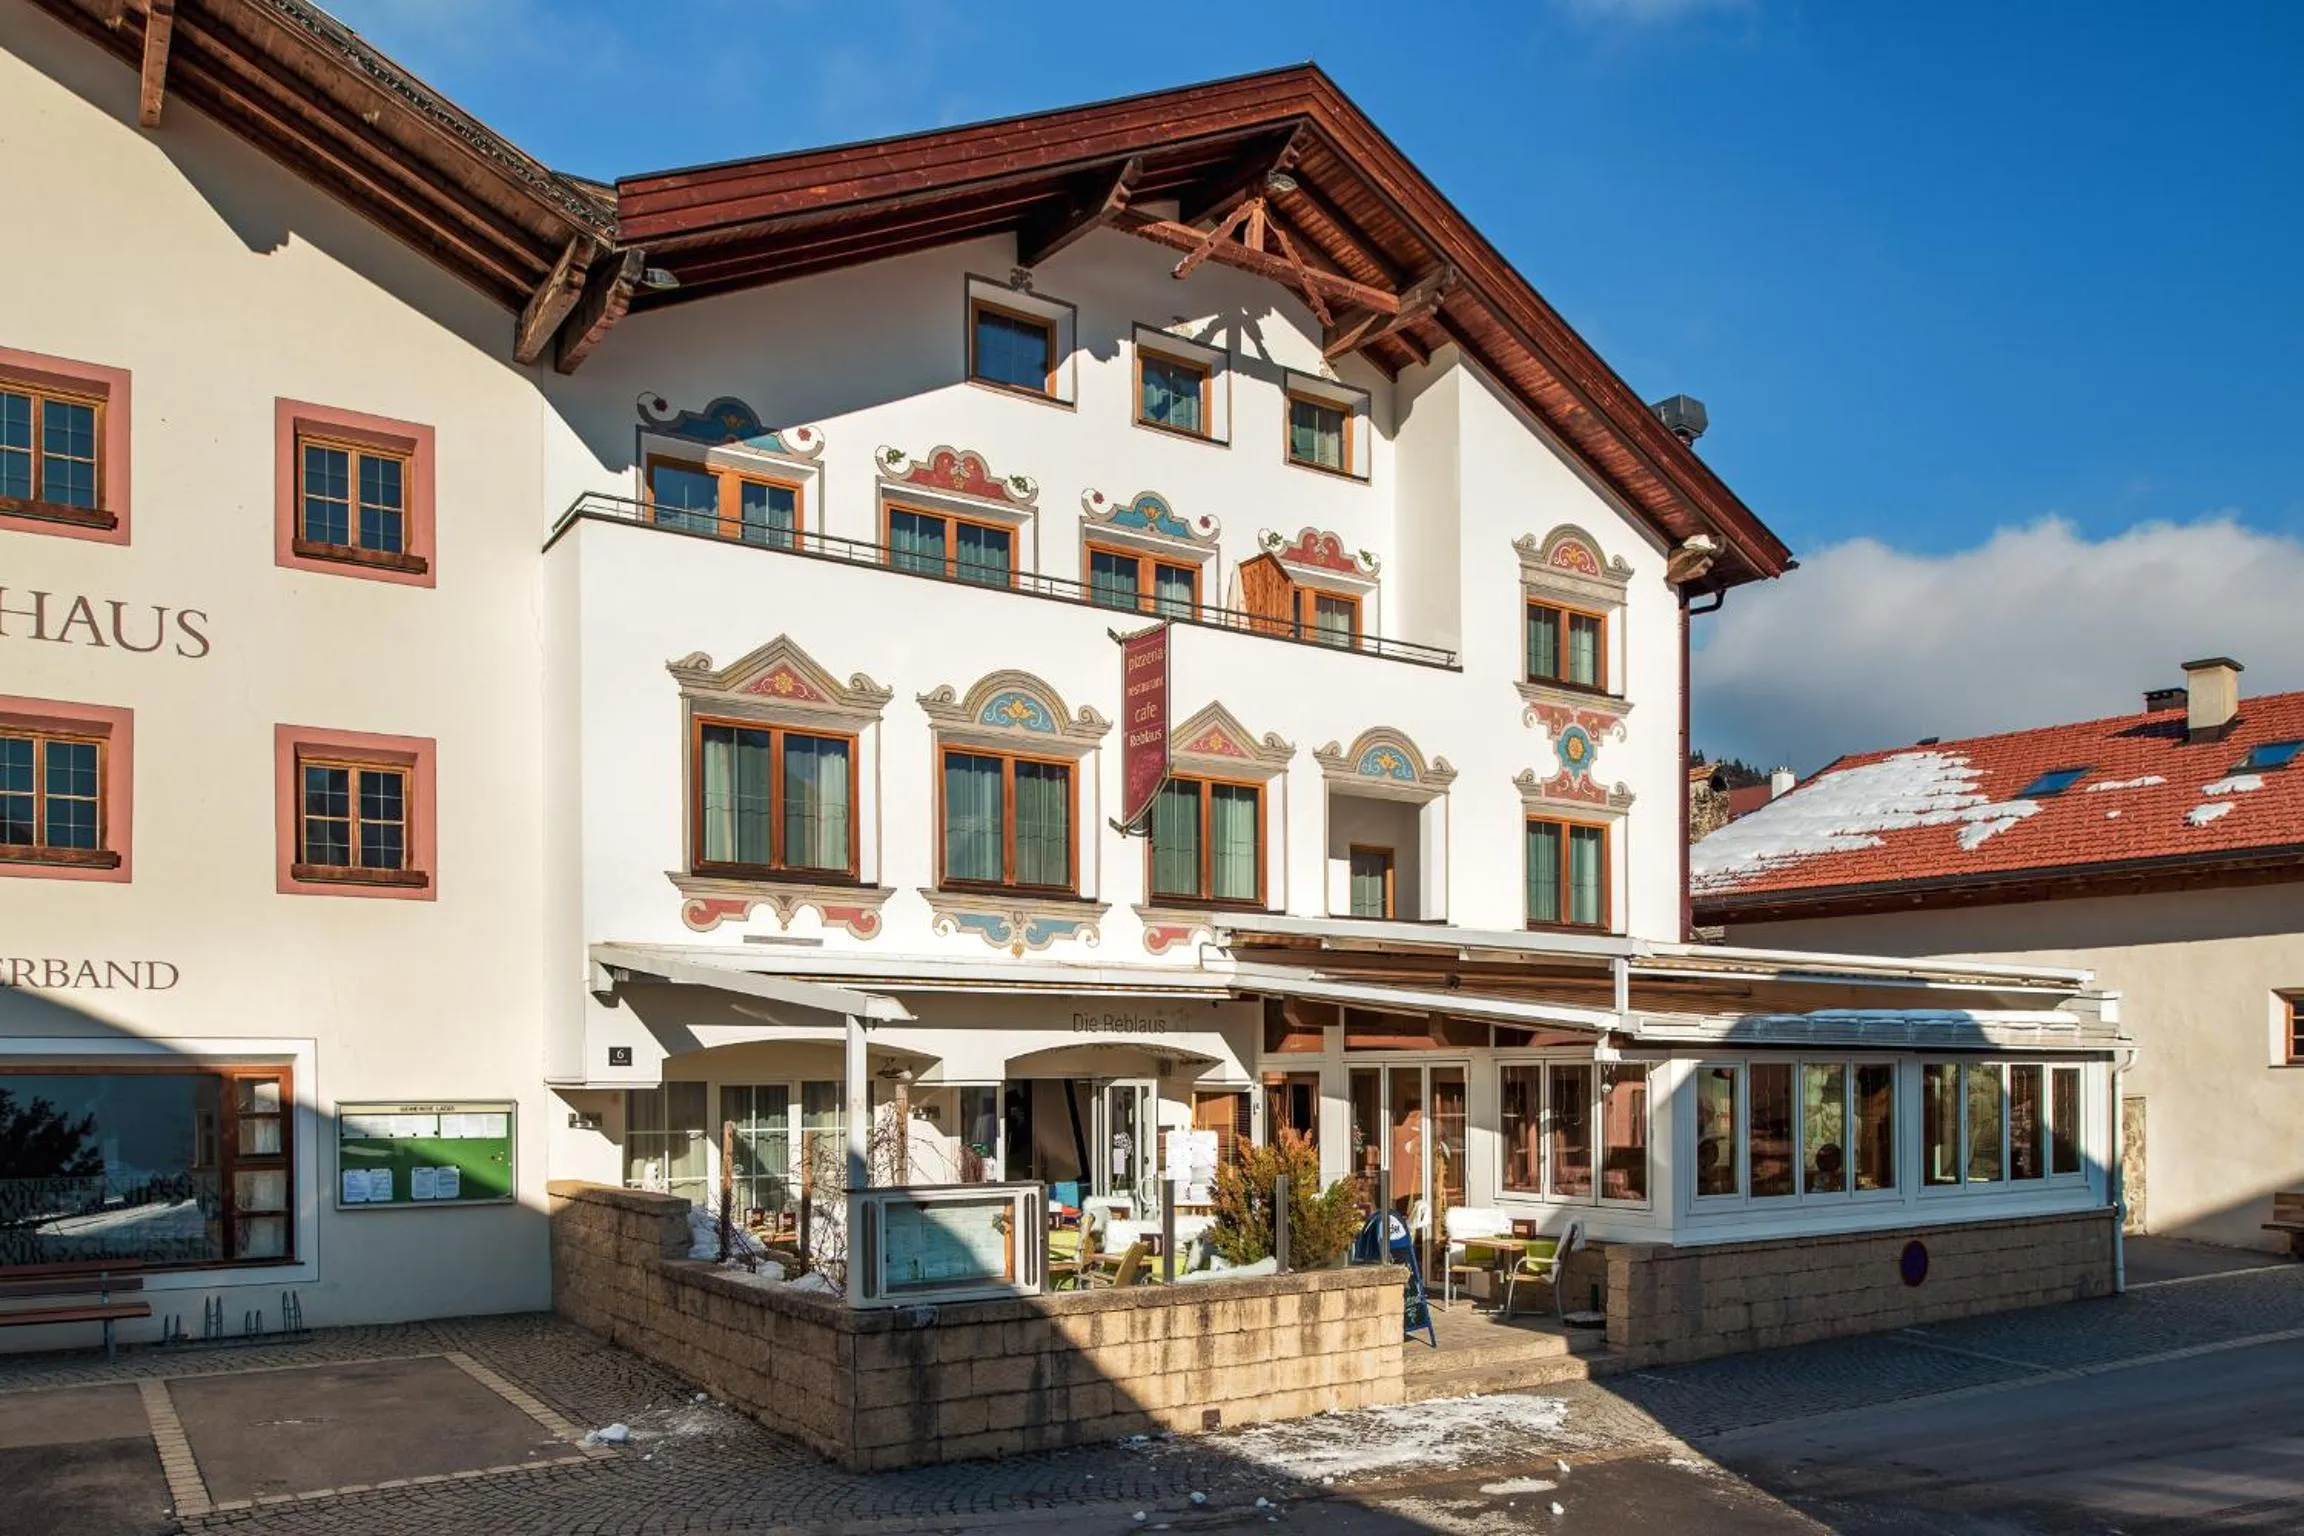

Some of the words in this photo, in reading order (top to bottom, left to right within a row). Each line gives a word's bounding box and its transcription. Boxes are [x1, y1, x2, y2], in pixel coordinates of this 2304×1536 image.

[0, 586, 211, 658] HAUS
[1128, 647, 1164, 675] pizzeria
[1073, 1013, 1098, 1033] Die
[1103, 1012, 1167, 1034] Reblaus
[616, 1048, 625, 1060] 6
